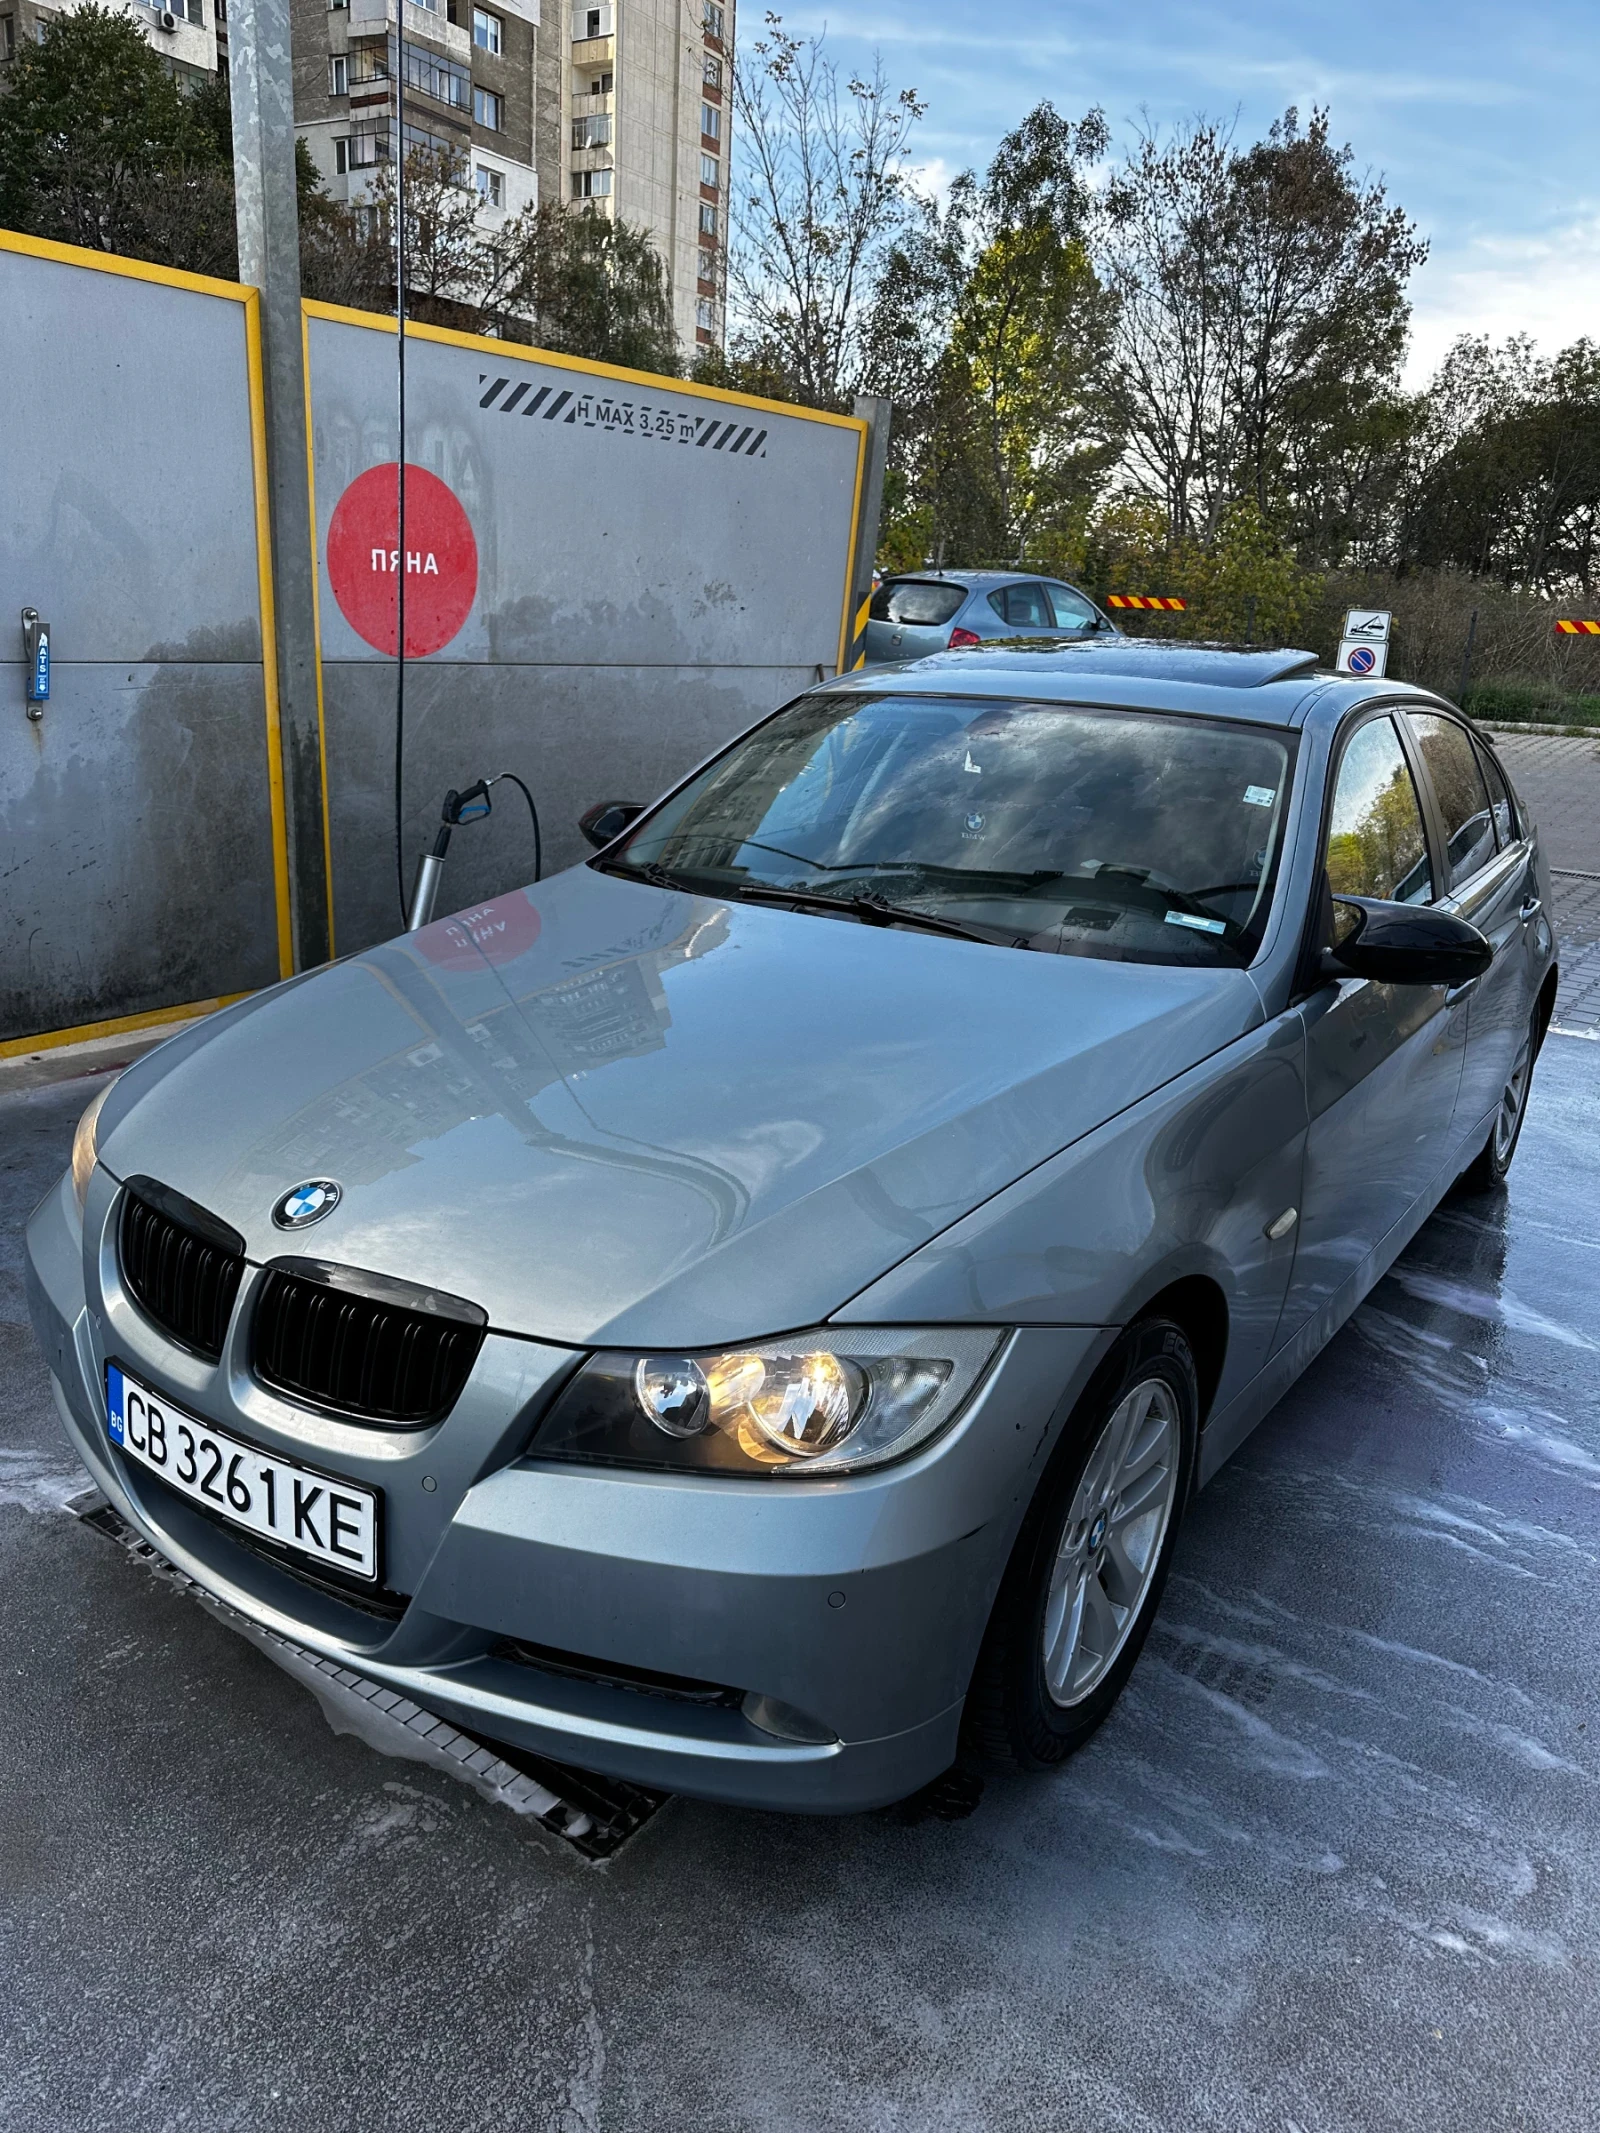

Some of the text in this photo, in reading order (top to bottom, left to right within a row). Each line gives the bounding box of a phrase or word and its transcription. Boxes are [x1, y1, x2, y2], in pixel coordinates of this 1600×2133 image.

[577, 401, 694, 437] H MAX 3.25 m
[111, 1410, 123, 1432] BG
[127, 1391, 364, 1563] CB 3261 KE
